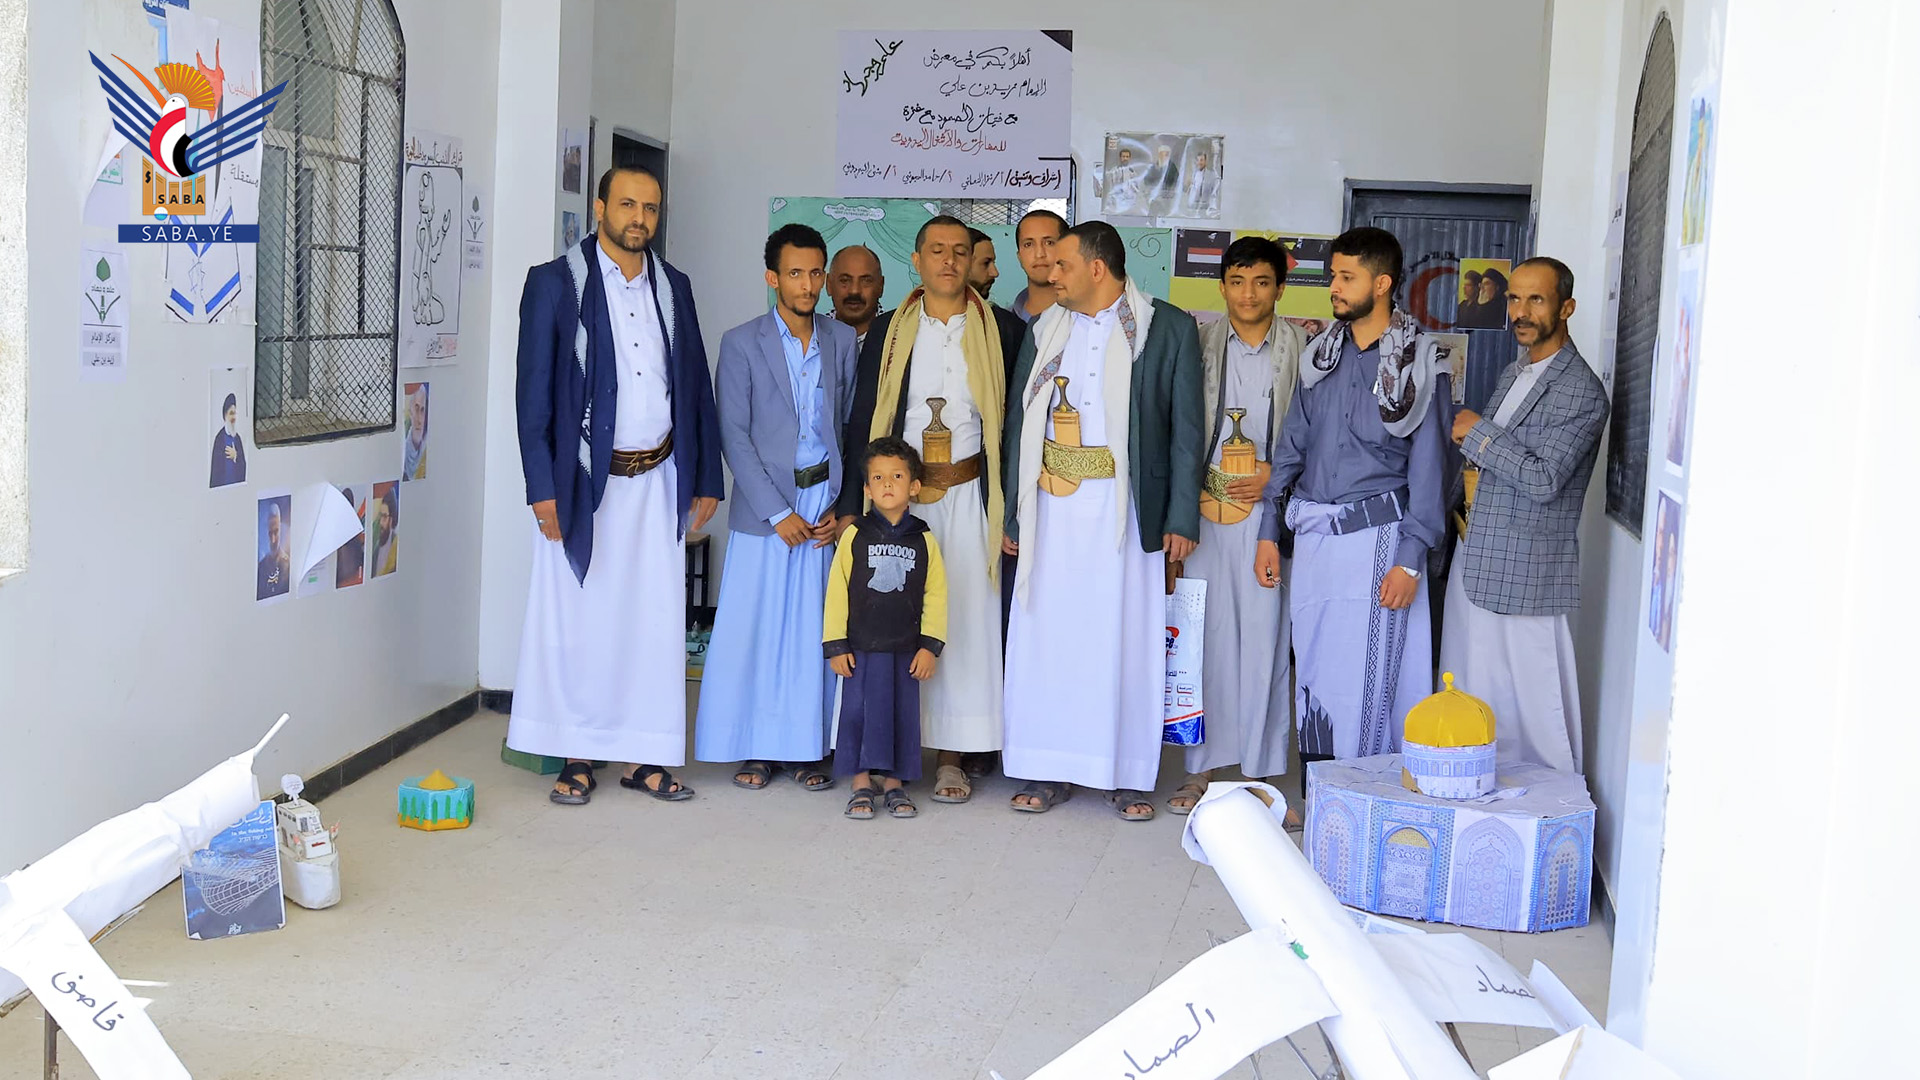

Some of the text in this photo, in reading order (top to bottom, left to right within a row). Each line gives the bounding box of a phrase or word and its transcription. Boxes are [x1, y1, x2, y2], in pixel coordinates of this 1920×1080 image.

[923, 48, 958, 69] معرض
[955, 50, 976, 70] في
[976, 46, 1008, 70] بكم
[940, 73, 966, 97] علي
[968, 83, 990, 97] بن
[989, 82, 1018, 100] زيد
[902, 102, 925, 122] غزة
[918, 109, 936, 125] مع
[938, 102, 974, 130] الصمود
[1004, 113, 1018, 125] مع
[868, 544, 916, 560] BOYGOOD
